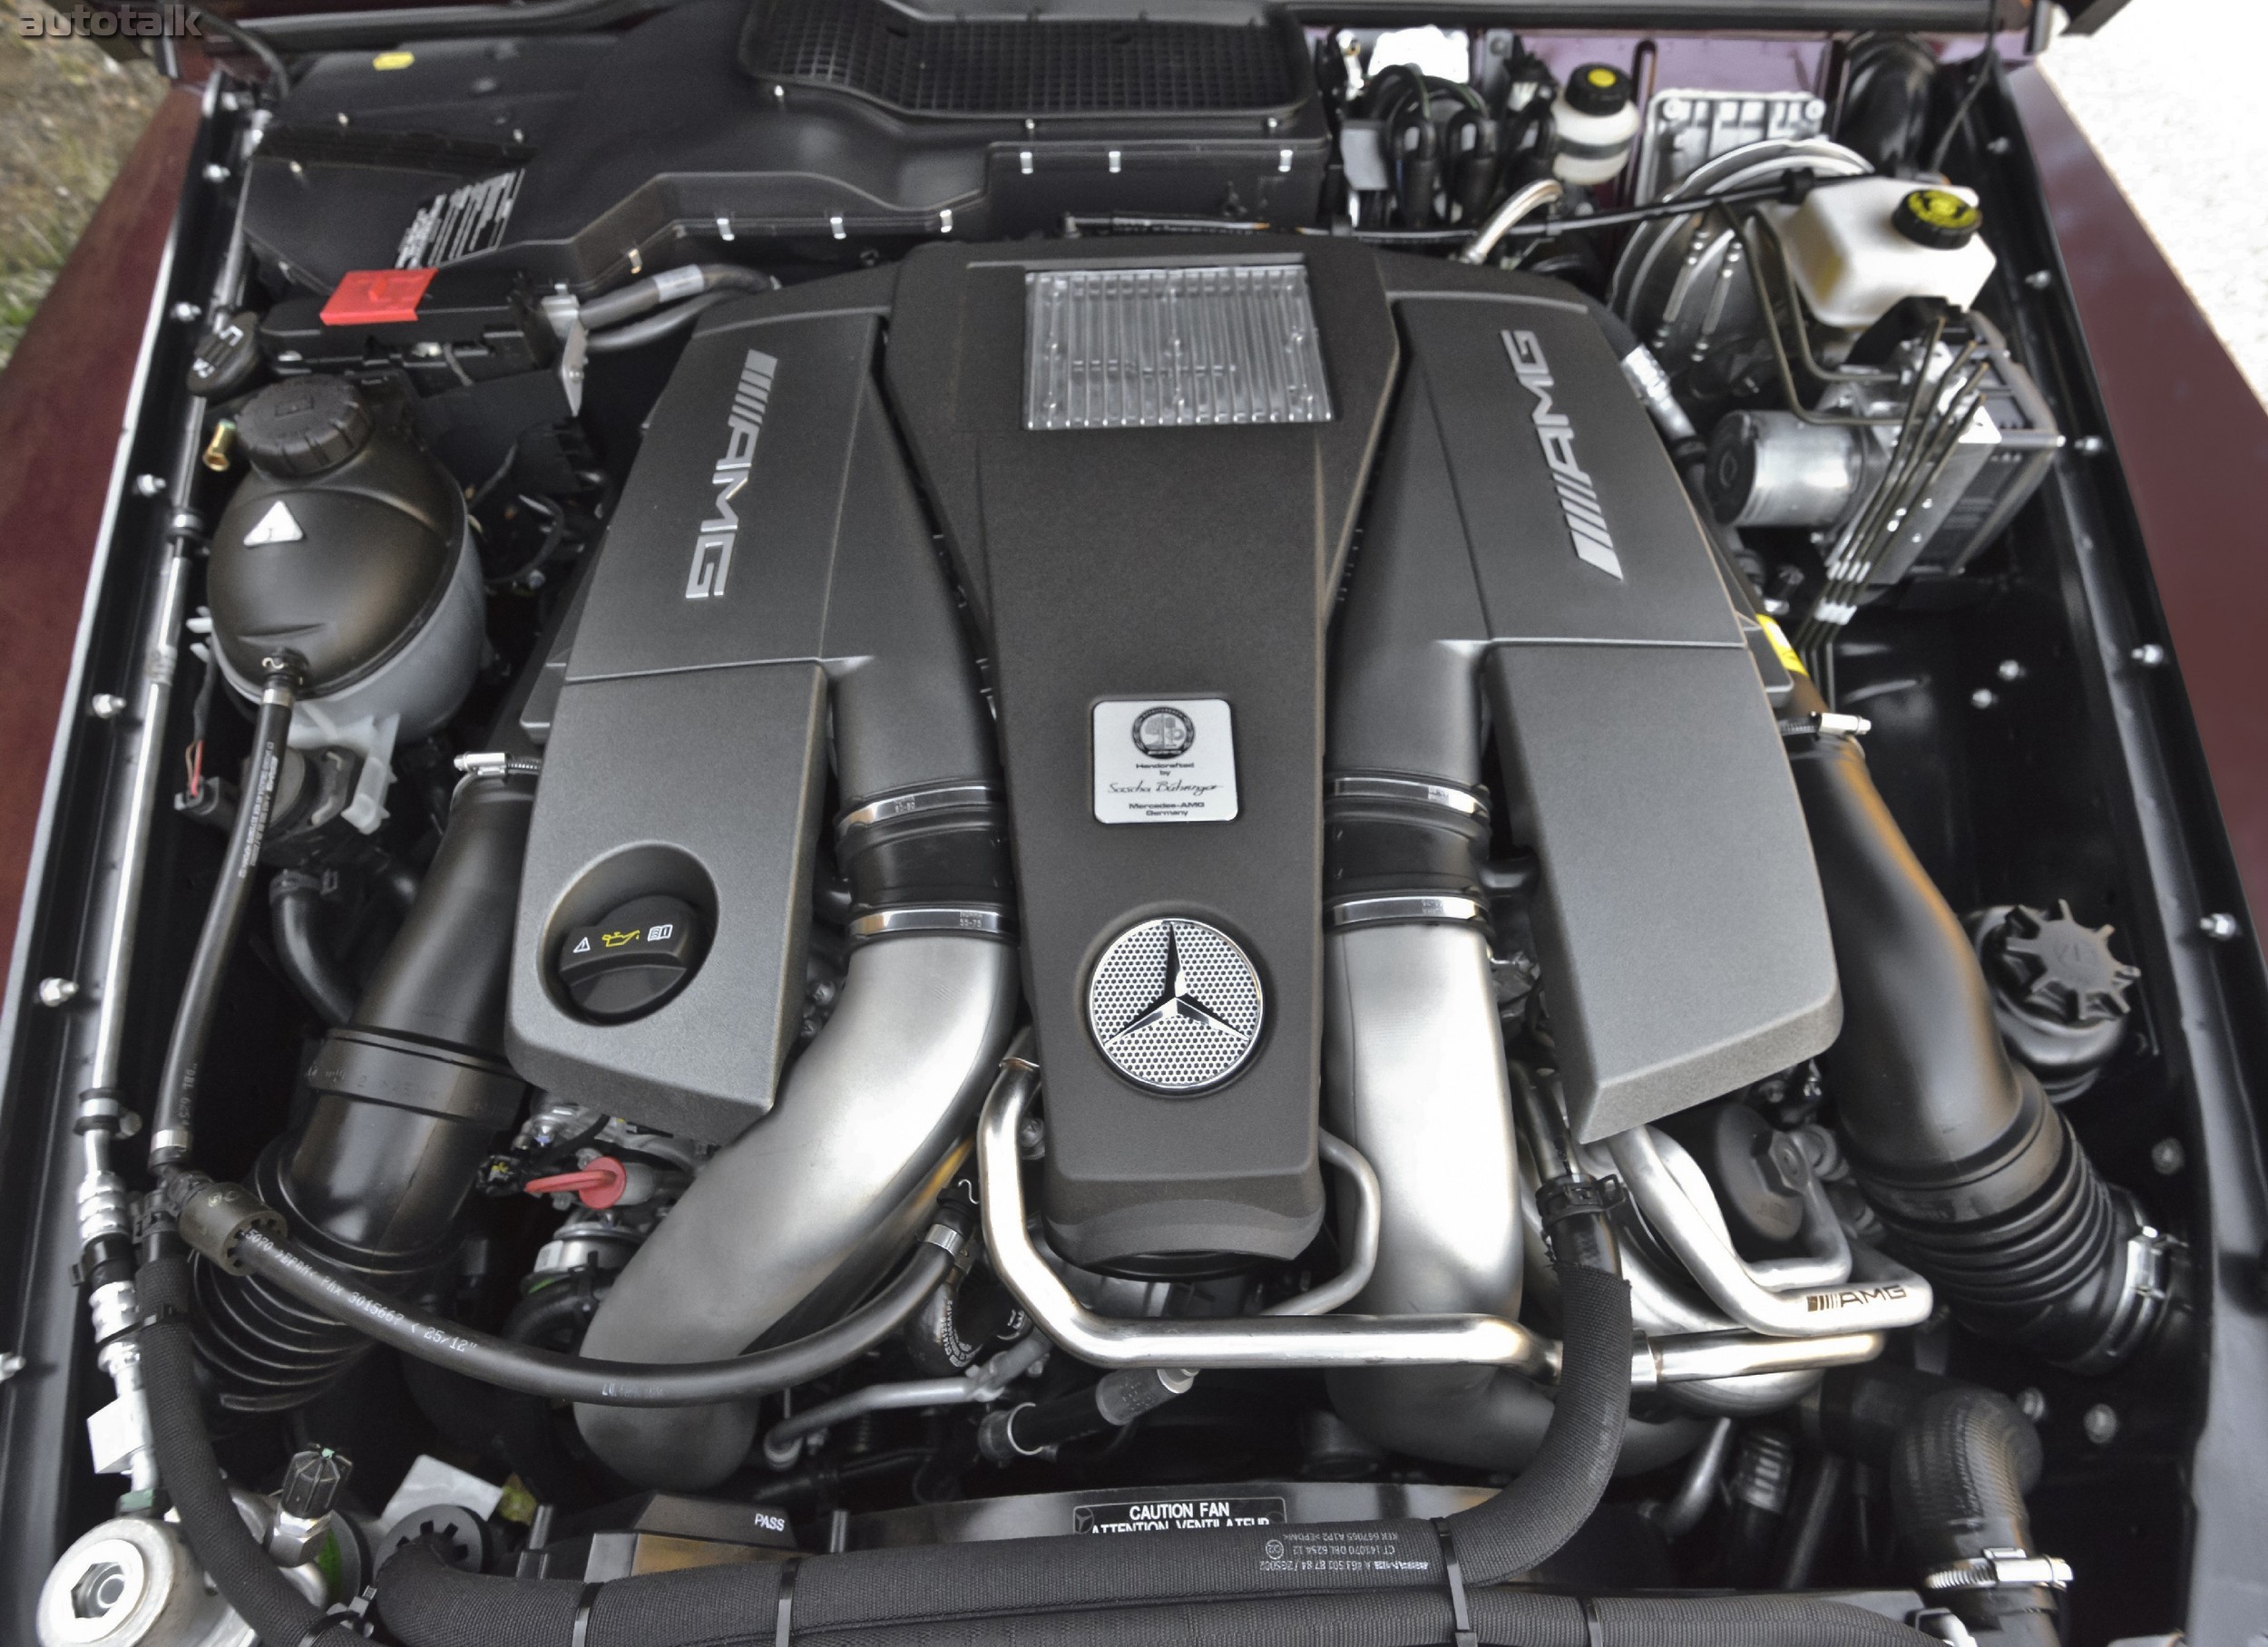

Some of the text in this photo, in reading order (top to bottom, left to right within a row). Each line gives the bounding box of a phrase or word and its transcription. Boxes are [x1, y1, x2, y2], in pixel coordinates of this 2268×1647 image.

[686, 413, 763, 599] AMG
[1129, 802, 1205, 810] Mercedes-AMG
[1839, 1284, 1907, 1308] AMG
[1129, 1502, 1230, 1521] CAUTION FAN
[754, 1513, 786, 1532] PASS
